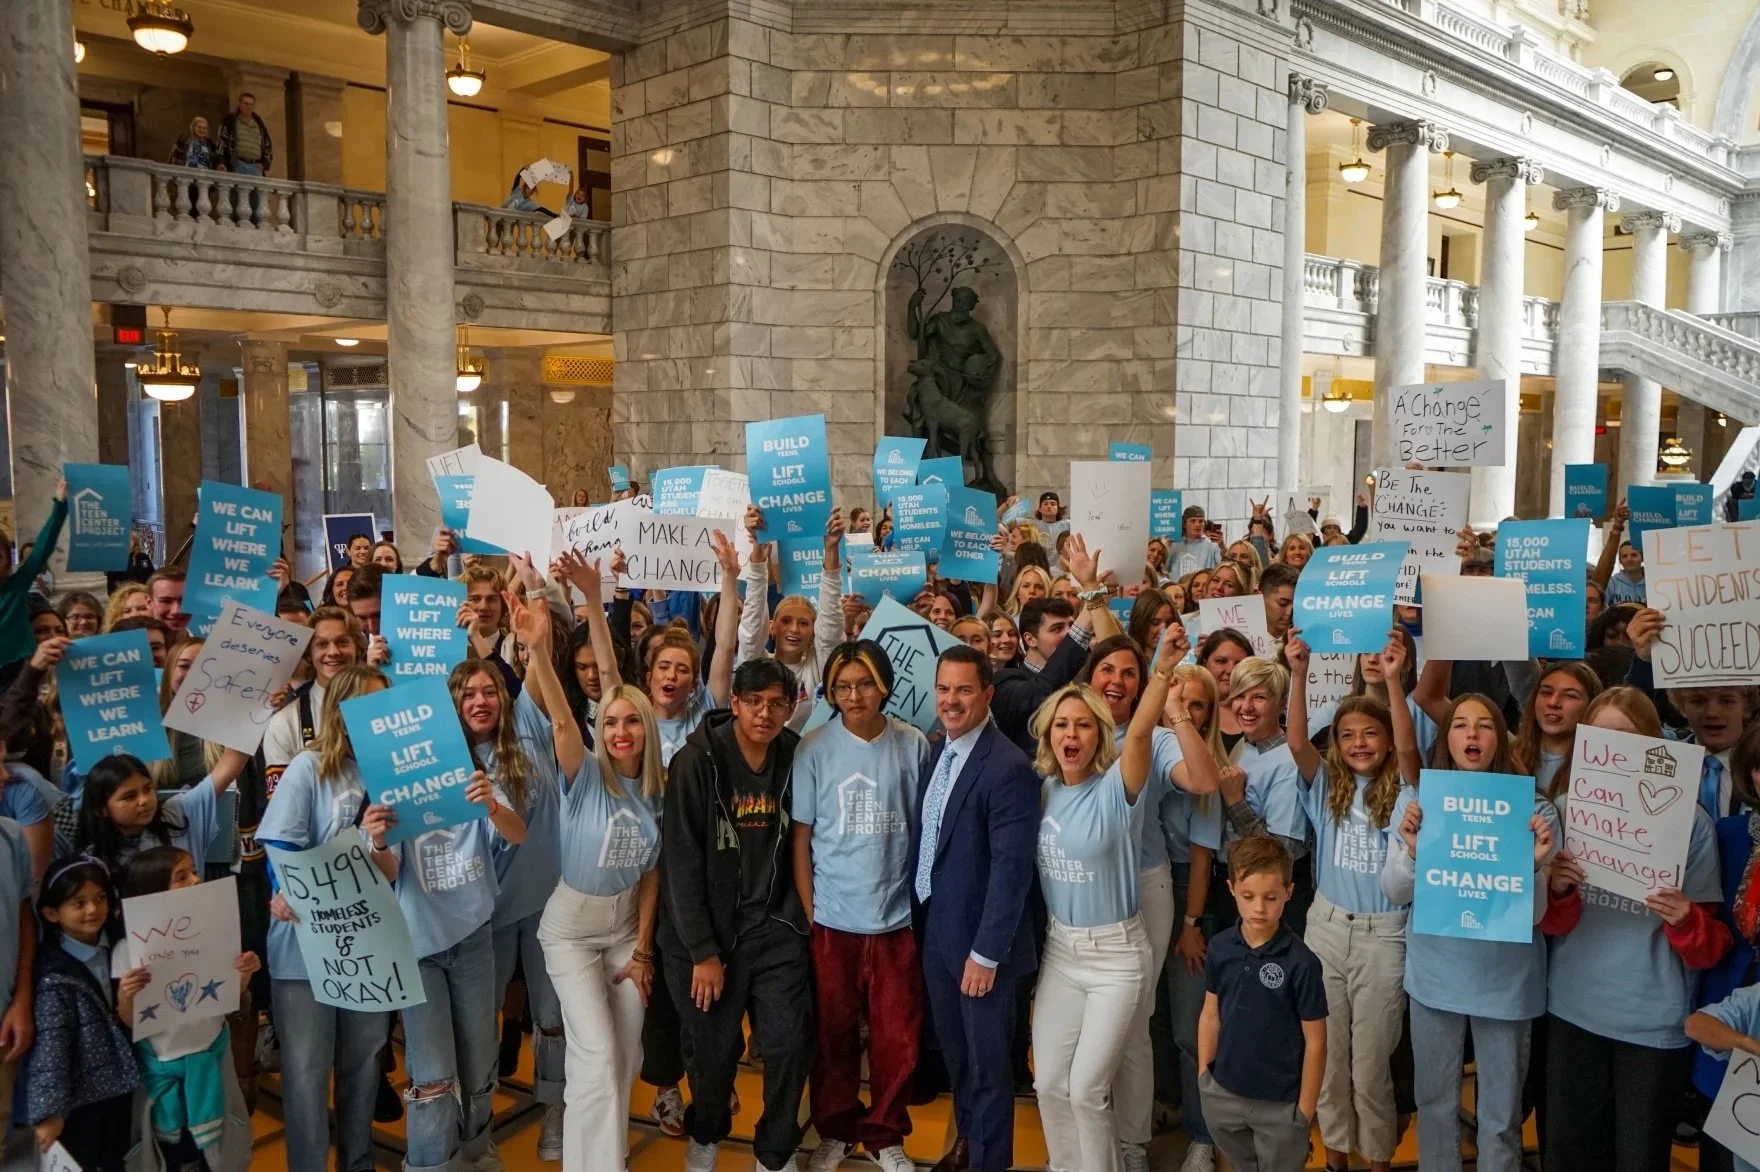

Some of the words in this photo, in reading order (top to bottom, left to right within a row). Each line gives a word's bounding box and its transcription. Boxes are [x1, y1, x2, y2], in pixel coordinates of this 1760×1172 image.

[1395, 395, 1406, 414] A
[1411, 393, 1481, 425] Change
[1403, 423, 1426, 435] For
[1436, 422, 1467, 436] The
[763, 436, 810, 453] BUILD
[1399, 439, 1489, 462] Better
[1128, 452, 1145, 460] CAN
[772, 464, 804, 480] LIFT
[1409, 476, 1432, 495] The
[661, 491, 700, 500] STUDENT
[758, 491, 826, 509] CHANGE
[1676, 494, 1704, 503] BUILD
[81, 501, 101, 509] THE
[212, 501, 237, 517] WE
[241, 506, 273, 523] CAN
[660, 507, 696, 515] HOMELE
[899, 507, 938, 516] STUDENTS
[81, 510, 108, 518] TEEN
[1678, 509, 1699, 518] LIFT
[82, 518, 120, 527] CENTER
[226, 521, 257, 537] LIFT
[1377, 521, 1396, 533] you
[1403, 524, 1439, 534] want
[1444, 526, 1456, 535] to
[82, 527, 126, 536] PROJECT
[639, 521, 688, 547] MAKE
[695, 528, 713, 547] A
[950, 530, 964, 538] WE
[212, 537, 267, 556] WHERE
[967, 541, 991, 551] EACH
[1506, 537, 1549, 549] 15,000
[793, 550, 825, 562] BUIL
[956, 550, 984, 560] OTHER.
[1328, 552, 1385, 563] BUILD
[1426, 548, 1445, 558] the
[1505, 549, 1540, 559] UTAH
[224, 557, 248, 572] WE
[626, 555, 722, 585] CHANGE
[858, 566, 921, 578] CHANGE
[1504, 559, 1572, 571] STUDENTS
[204, 573, 260, 592] LEARN.
[1328, 570, 1369, 581] LIFT
[1526, 583, 1576, 594] MELESS.
[394, 592, 420, 606] WE
[424, 593, 457, 608] CAN
[1302, 595, 1385, 610] CHANGE
[409, 610, 440, 623] LIFT
[1217, 604, 1246, 624] WE
[1527, 607, 1554, 618] CAN
[397, 627, 451, 641] WHERE
[220, 638, 281, 664] deserves
[411, 645, 436, 657] WE
[885, 634, 925, 676] THE
[70, 656, 98, 672] WE
[103, 648, 140, 664] CAN
[395, 662, 449, 676] LEARN.
[90, 670, 125, 687] LIFT
[1324, 669, 1353, 685] the
[80, 685, 140, 706] WHERE
[99, 706, 128, 722] WE
[370, 704, 434, 735] BUILD
[87, 721, 147, 743] LEARN.
[391, 740, 433, 766] LIFT
[1583, 739, 1640, 773] We
[380, 767, 469, 806] CHANGE
[847, 789, 873, 801] THE
[343, 804, 359, 816] TH
[847, 801, 883, 812] TEEN
[1443, 796, 1511, 816] BUILD
[847, 811, 899, 823] CENTER
[1461, 814, 1495, 824] TEENS.
[614, 826, 639, 838] THE
[847, 822, 907, 835] PROJECT
[1343, 820, 1367, 836] THE
[612, 837, 648, 848] TEEN
[1343, 832, 1378, 849] TEEN
[1452, 833, 1499, 852] LIFT
[424, 841, 452, 856] THE
[608, 848, 653, 860] CENTE
[1343, 845, 1387, 861] CENTE
[1450, 850, 1499, 862] SCHOOLS.
[425, 851, 464, 867] TEEN
[606, 856, 649, 869] PROJE
[1038, 856, 1084, 871] CENTER
[1341, 857, 1378, 874] PROJ
[279, 844, 379, 905] 15,499
[425, 855, 485, 880] CENTER
[427, 868, 485, 893] PROJEC
[1041, 867, 1095, 884] PROJECT
[1426, 869, 1524, 893] CHANGE
[1458, 889, 1488, 900] LIVES.
[311, 900, 369, 922] HOMELESS
[311, 912, 381, 934] STUDENTS
[323, 955, 374, 977] NOT
[323, 961, 407, 1004] OKAY!
